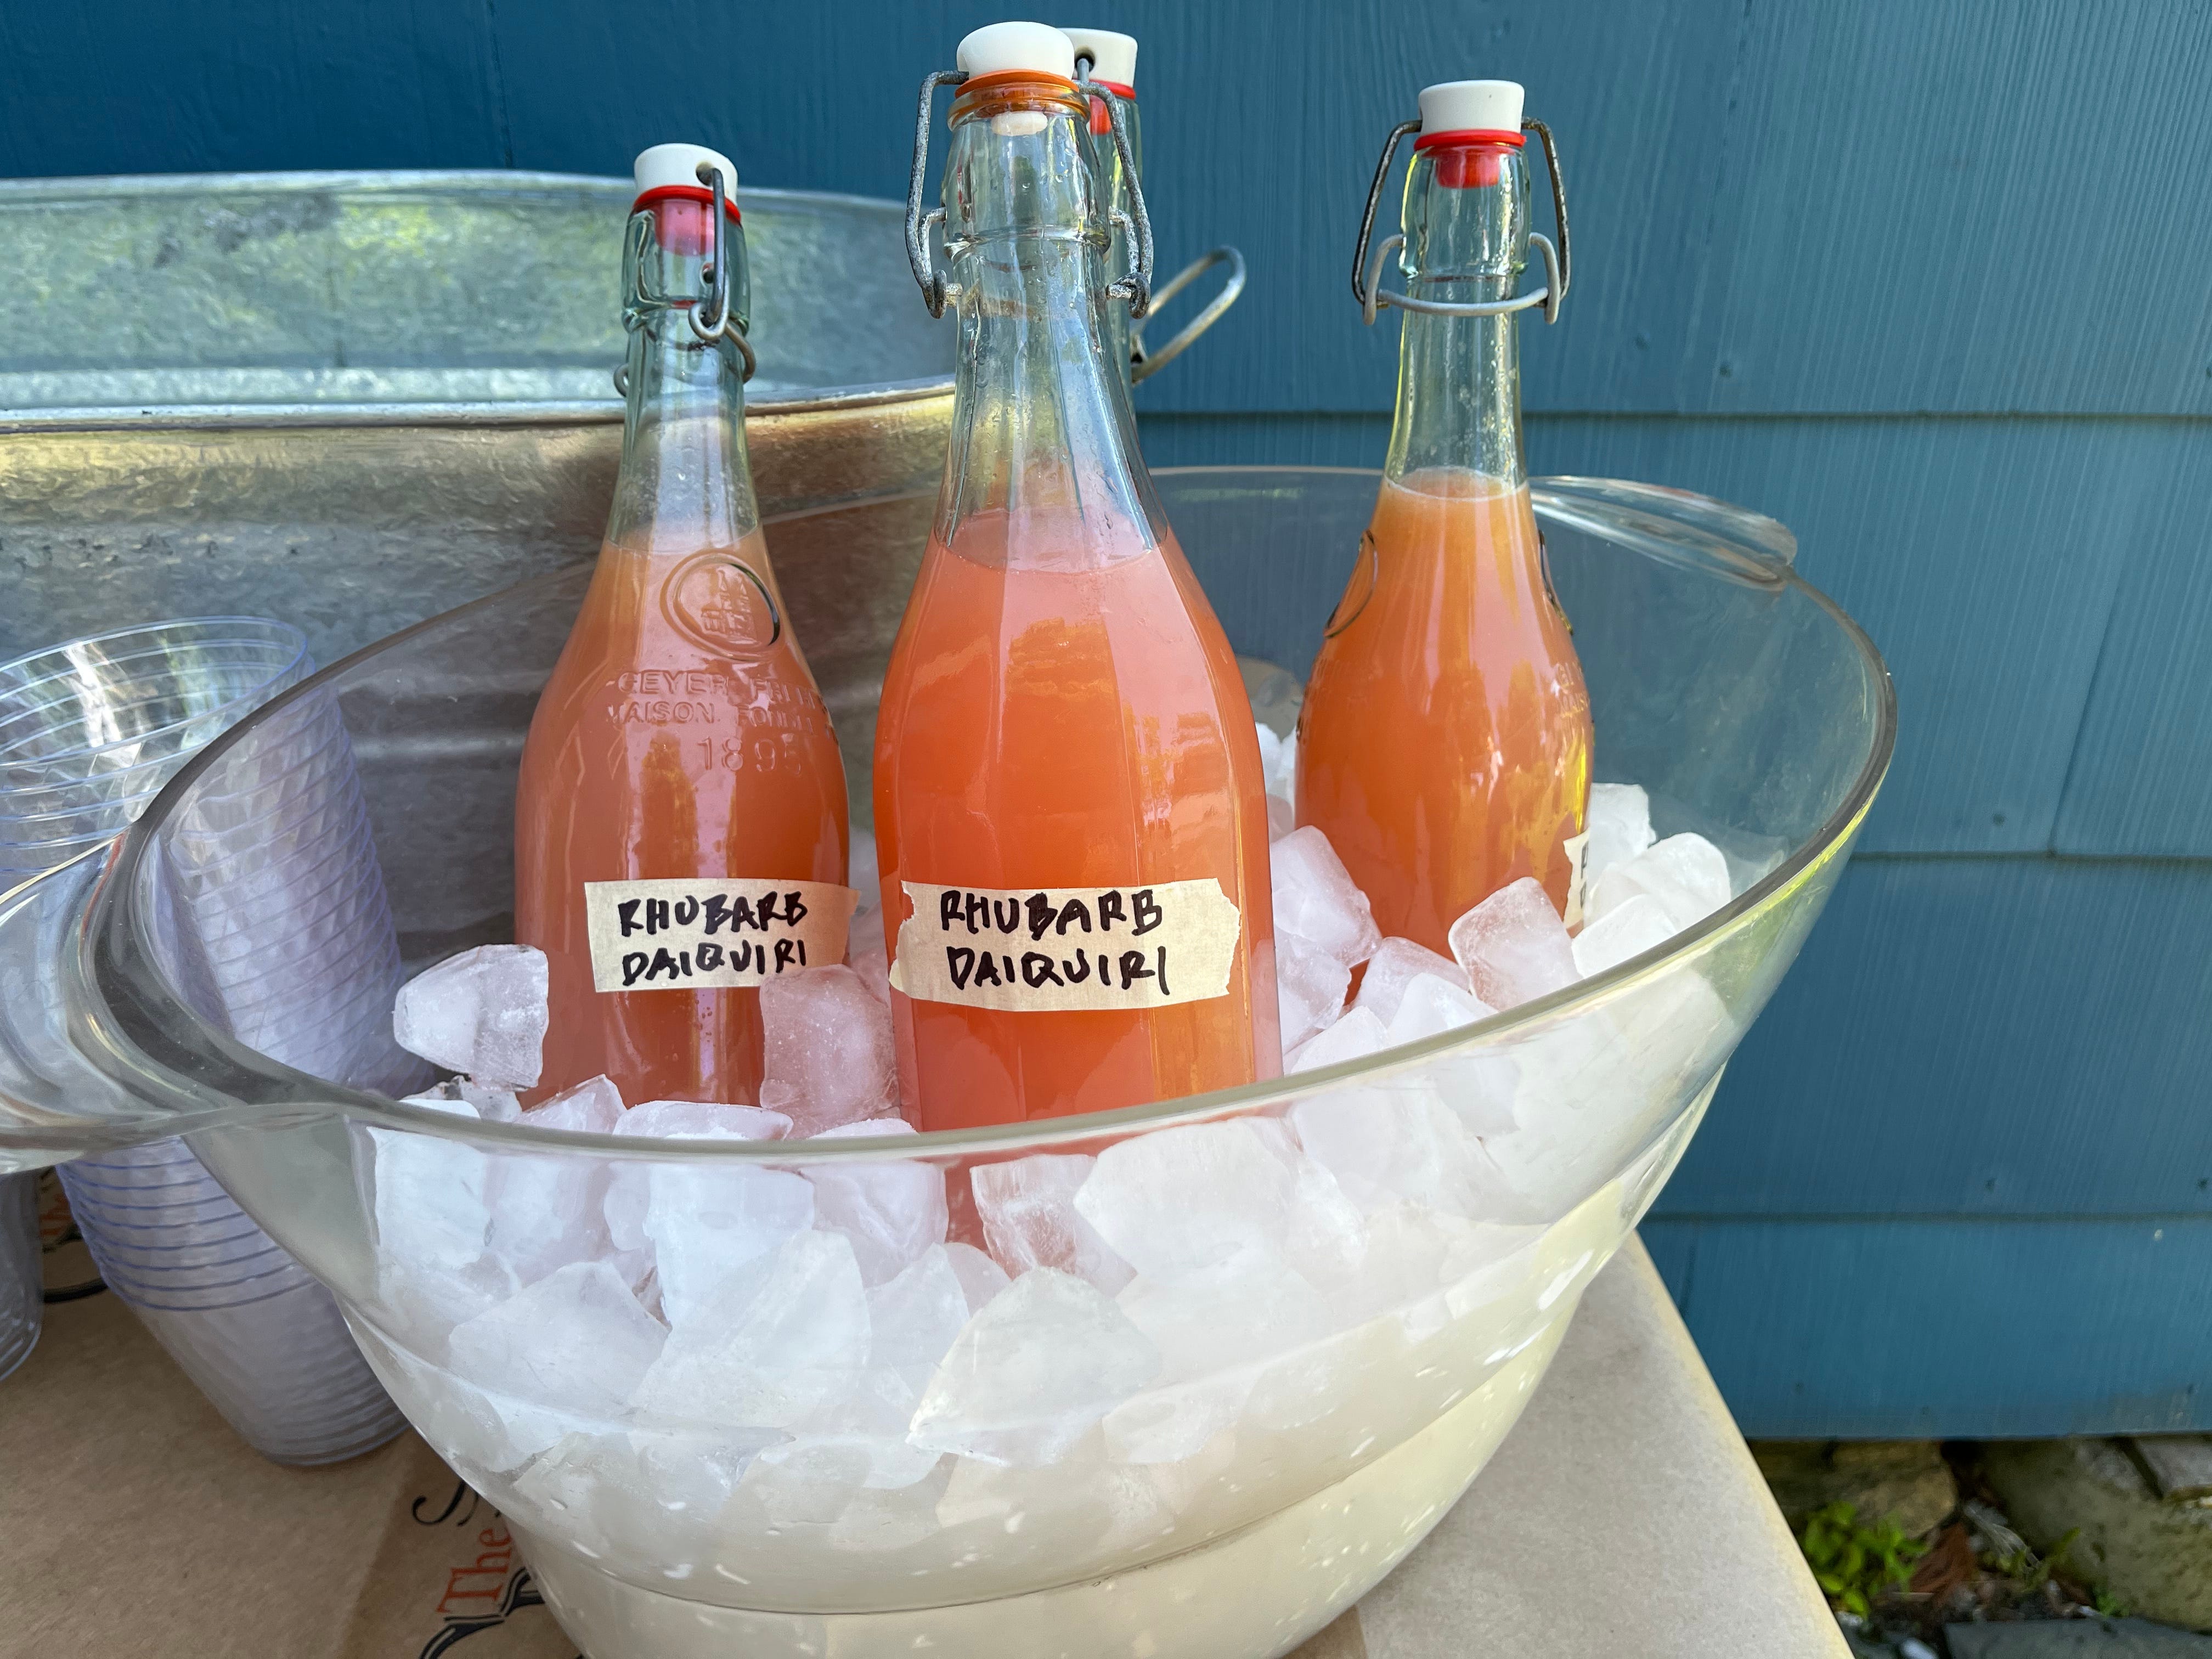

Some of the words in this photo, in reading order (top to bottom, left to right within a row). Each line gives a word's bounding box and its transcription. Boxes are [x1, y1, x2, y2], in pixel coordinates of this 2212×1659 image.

[618, 669, 729, 696] GEYER
[697, 733, 803, 777] 1895
[618, 891, 808, 936] RHUBARB
[940, 889, 1162, 940] RHUBARB
[622, 939, 806, 986] DAIQUIRI
[946, 946, 1170, 996] DAIQUIRI
[436, 1527, 513, 1613] The
